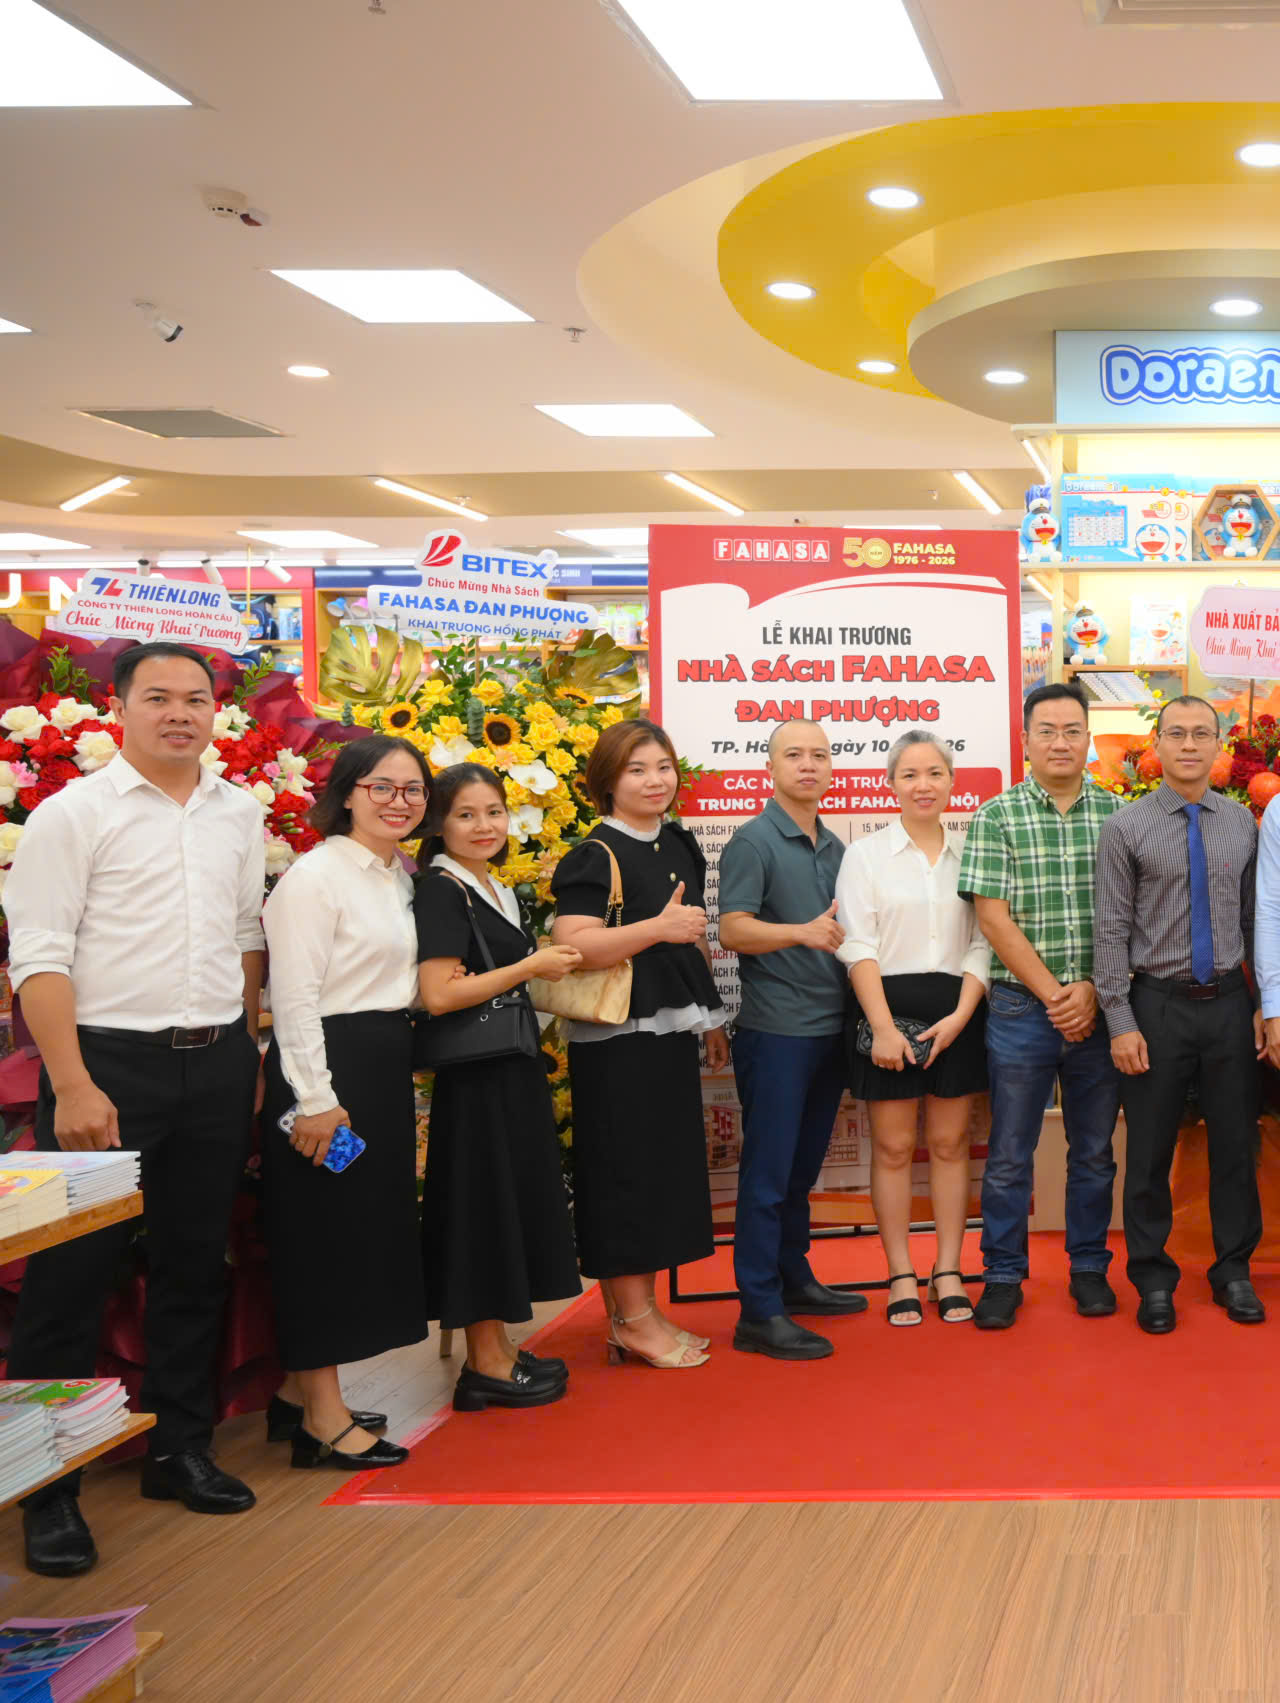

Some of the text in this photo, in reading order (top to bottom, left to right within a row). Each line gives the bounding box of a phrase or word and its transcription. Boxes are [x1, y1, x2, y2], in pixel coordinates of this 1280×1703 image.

[715, 540, 829, 561] FAHASA
[842, 537, 892, 568] 50
[893, 543, 955, 554] FAHASA
[462, 554, 548, 579] BITEX
[894, 556, 918, 564] 1976
[928, 556, 955, 565] 2026
[428, 577, 540, 597] Chúc Mừng Nhà Sách
[77, 599, 107, 609] CÔNG
[125, 604, 154, 614] THIÊN
[156, 607, 183, 617] LONG
[379, 592, 589, 625] FAHASA ĐAN PHƯỢNG
[66, 611, 101, 627] Chúc
[111, 616, 155, 638] Mừng
[159, 619, 192, 636] Khai
[408, 618, 438, 630] KHAI
[1233, 608, 1262, 631] XUẤT
[762, 620, 912, 646] LỄ KHAI TRƯƠNG
[677, 654, 995, 682] NHÀ SÁCH FAHASA
[735, 696, 940, 727] ĐAN PHƯỢNG
[712, 741, 740, 754] TP.
[830, 739, 866, 756] gày
[724, 775, 758, 790] CÁC
[697, 797, 751, 811] TRUNG
[851, 796, 901, 809] FAHA
[951, 792, 979, 809] NỘI
[706, 823, 726, 836] SÁCH
[712, 966, 728, 977] ÁCH
